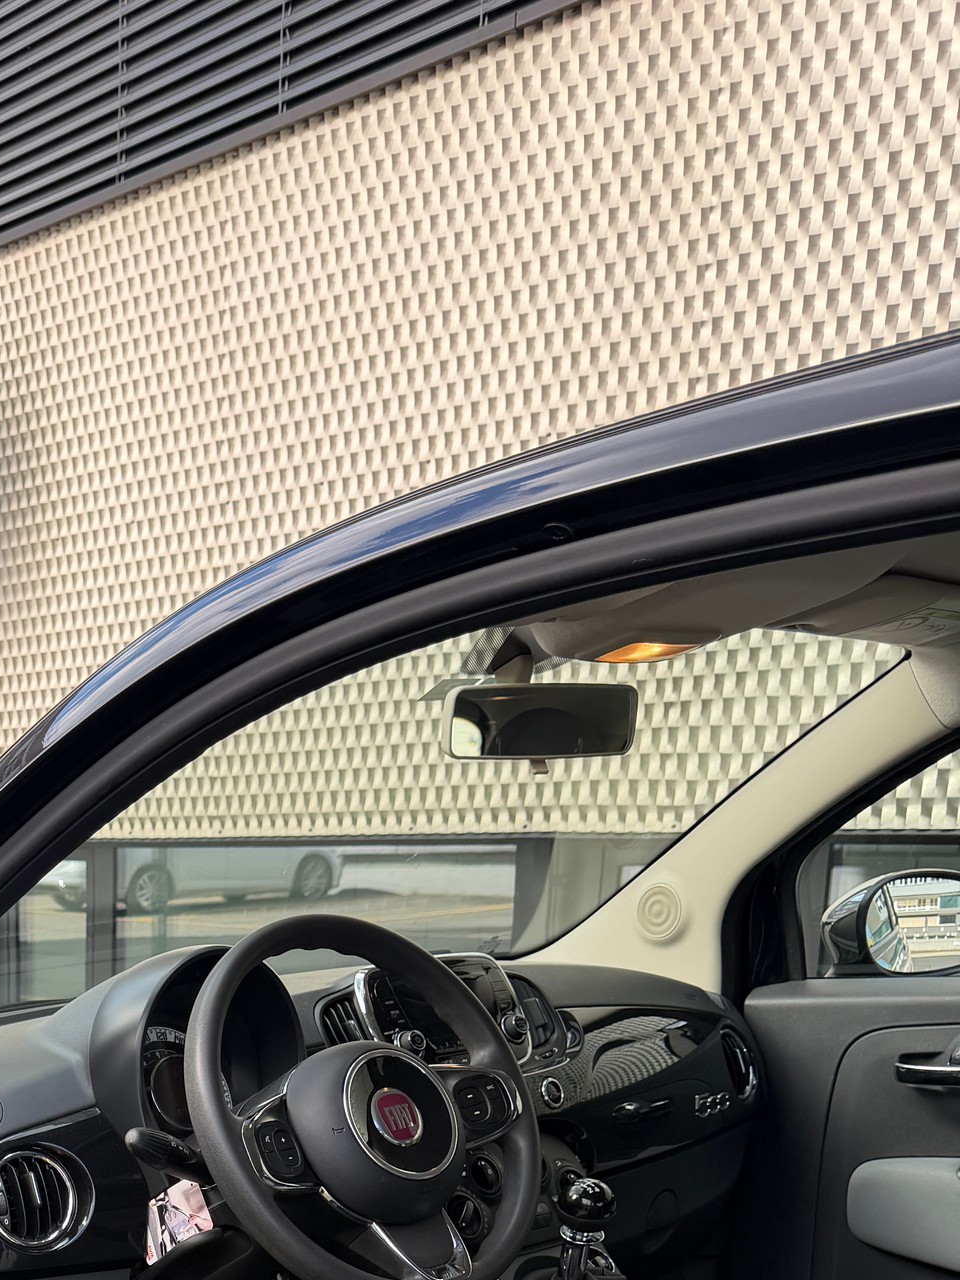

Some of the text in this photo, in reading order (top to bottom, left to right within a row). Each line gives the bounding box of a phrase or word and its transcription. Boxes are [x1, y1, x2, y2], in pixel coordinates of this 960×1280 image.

[156, 1031, 167, 1041] 120
[384, 1103, 413, 1131] FIAT
[695, 1091, 730, 1118] 500
